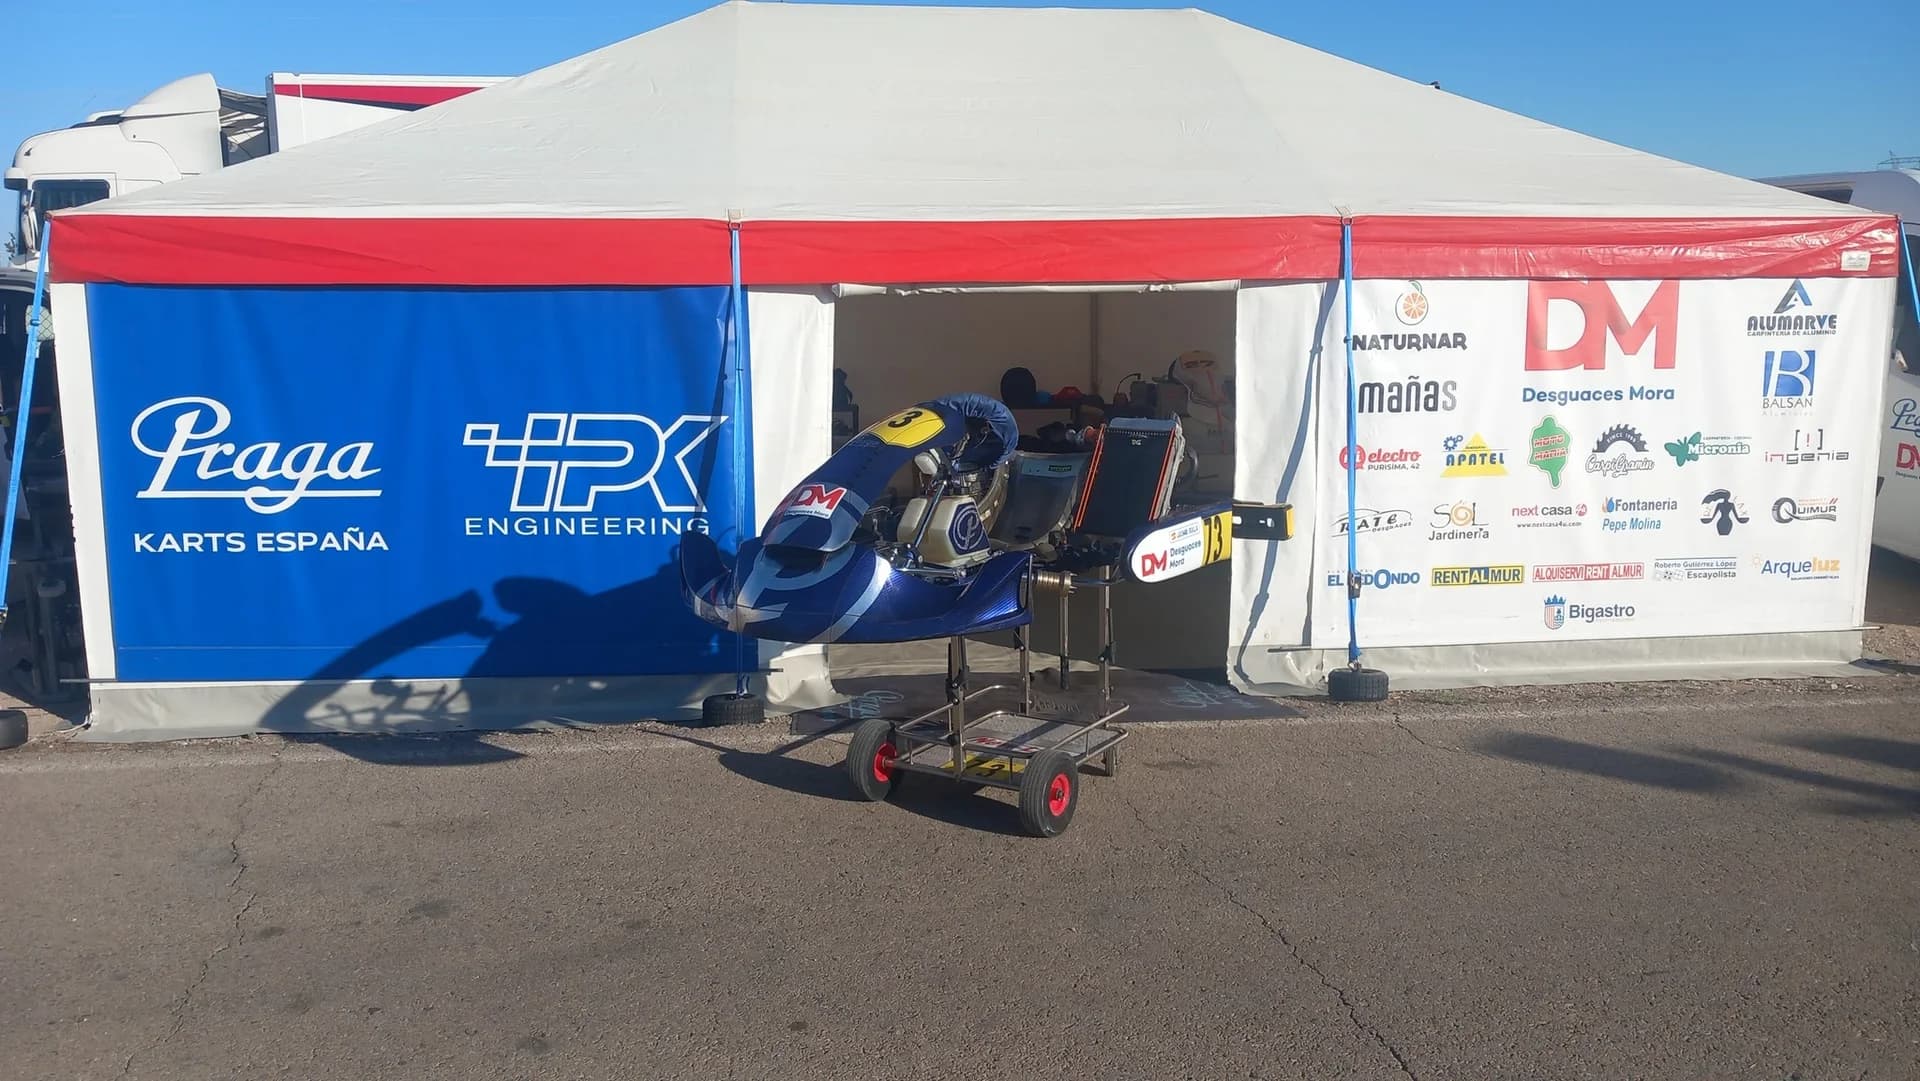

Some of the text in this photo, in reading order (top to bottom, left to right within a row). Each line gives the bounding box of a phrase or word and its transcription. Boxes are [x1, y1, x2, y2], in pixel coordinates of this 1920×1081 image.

[1524, 279, 1680, 371] DM
[1747, 314, 1837, 331] ALUMARVE
[1352, 332, 1467, 352] NATURNAR
[1358, 375, 1457, 414] mañas
[1522, 385, 1675, 406] Desguaces Mora
[1763, 397, 1814, 408] BALSAN
[887, 410, 923, 428] 3
[131, 396, 382, 514] Praga
[1368, 448, 1421, 463] electro
[1687, 441, 1751, 456] Micronia
[1765, 450, 1849, 465] ingenia
[1446, 452, 1505, 466] APATEL
[1511, 504, 1573, 517] next casa
[1772, 497, 1838, 524] QUIMUR
[464, 516, 710, 537] ENGINEERING
[1602, 518, 1661, 533] Pepe Molina
[133, 526, 390, 553] KARTS ESPAÑA
[1141, 549, 1167, 577] DM
[1761, 557, 1840, 578] Arqueluz
[1328, 574, 1345, 586] EL
[1534, 567, 1584, 580] ALQUISERVI
[1611, 565, 1642, 577] ALMUR
[1686, 571, 1737, 580] Escayolista
[1569, 604, 1635, 623] Bigastro
